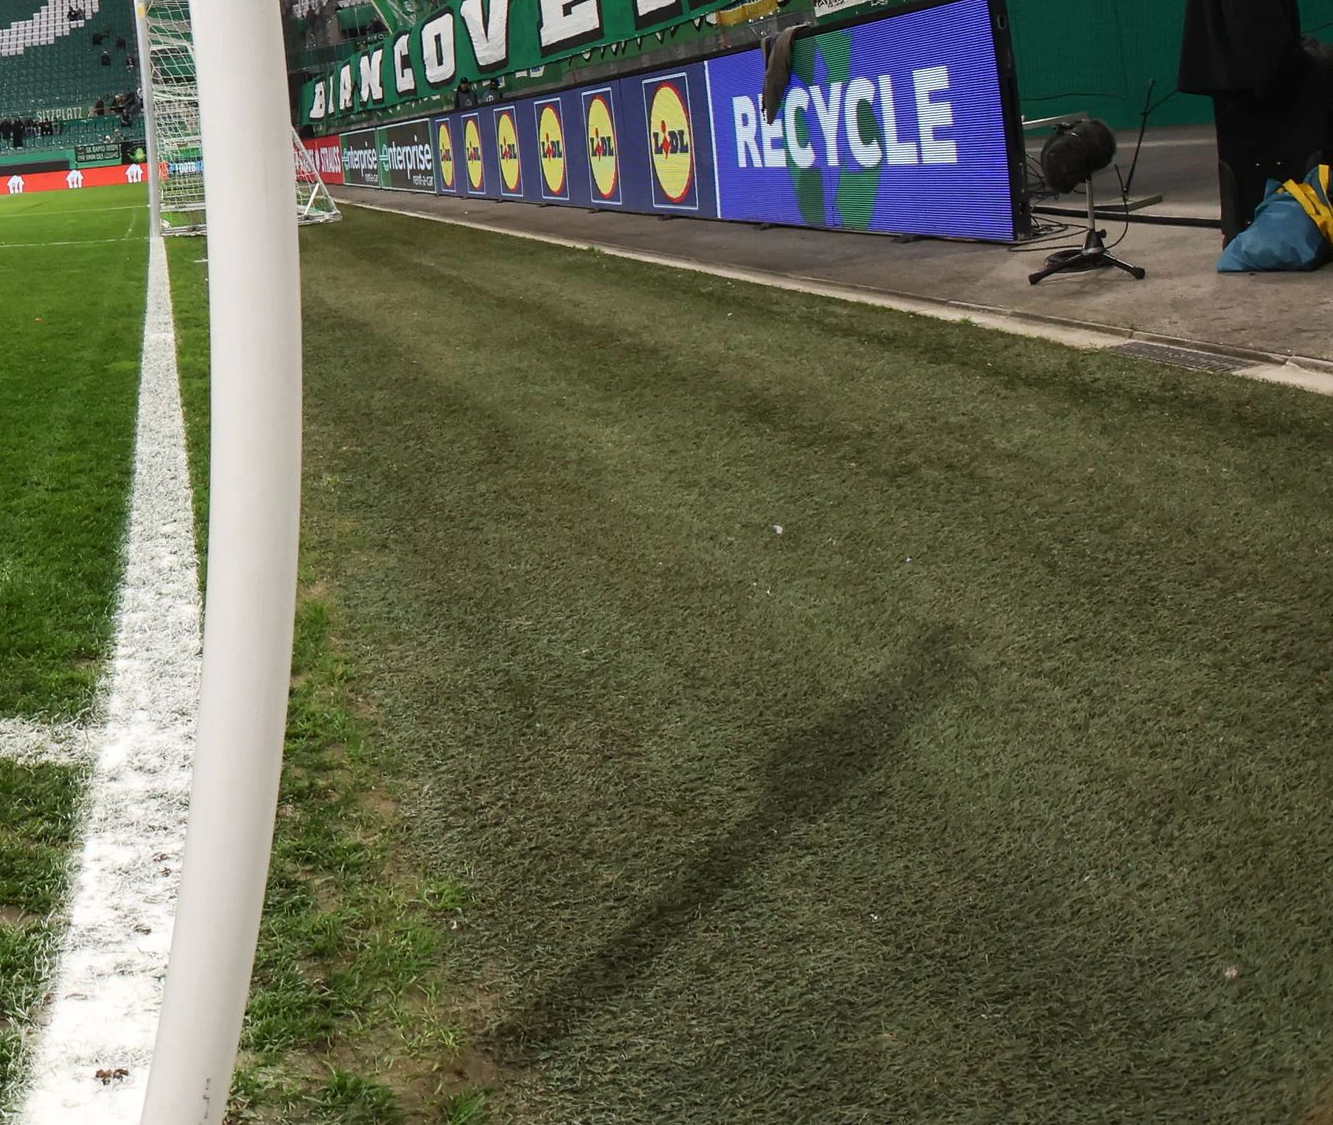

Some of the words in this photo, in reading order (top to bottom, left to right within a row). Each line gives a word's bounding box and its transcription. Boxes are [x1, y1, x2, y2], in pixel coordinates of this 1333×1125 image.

[732, 65, 958, 169] RECYCLE
[500, 140, 517, 160] LIDL
[541, 136, 563, 159] LIDL
[590, 131, 614, 158] LIDL
[652, 125, 690, 156] LIDL
[343, 141, 377, 177] enterprise
[381, 135, 432, 179] enterprise
